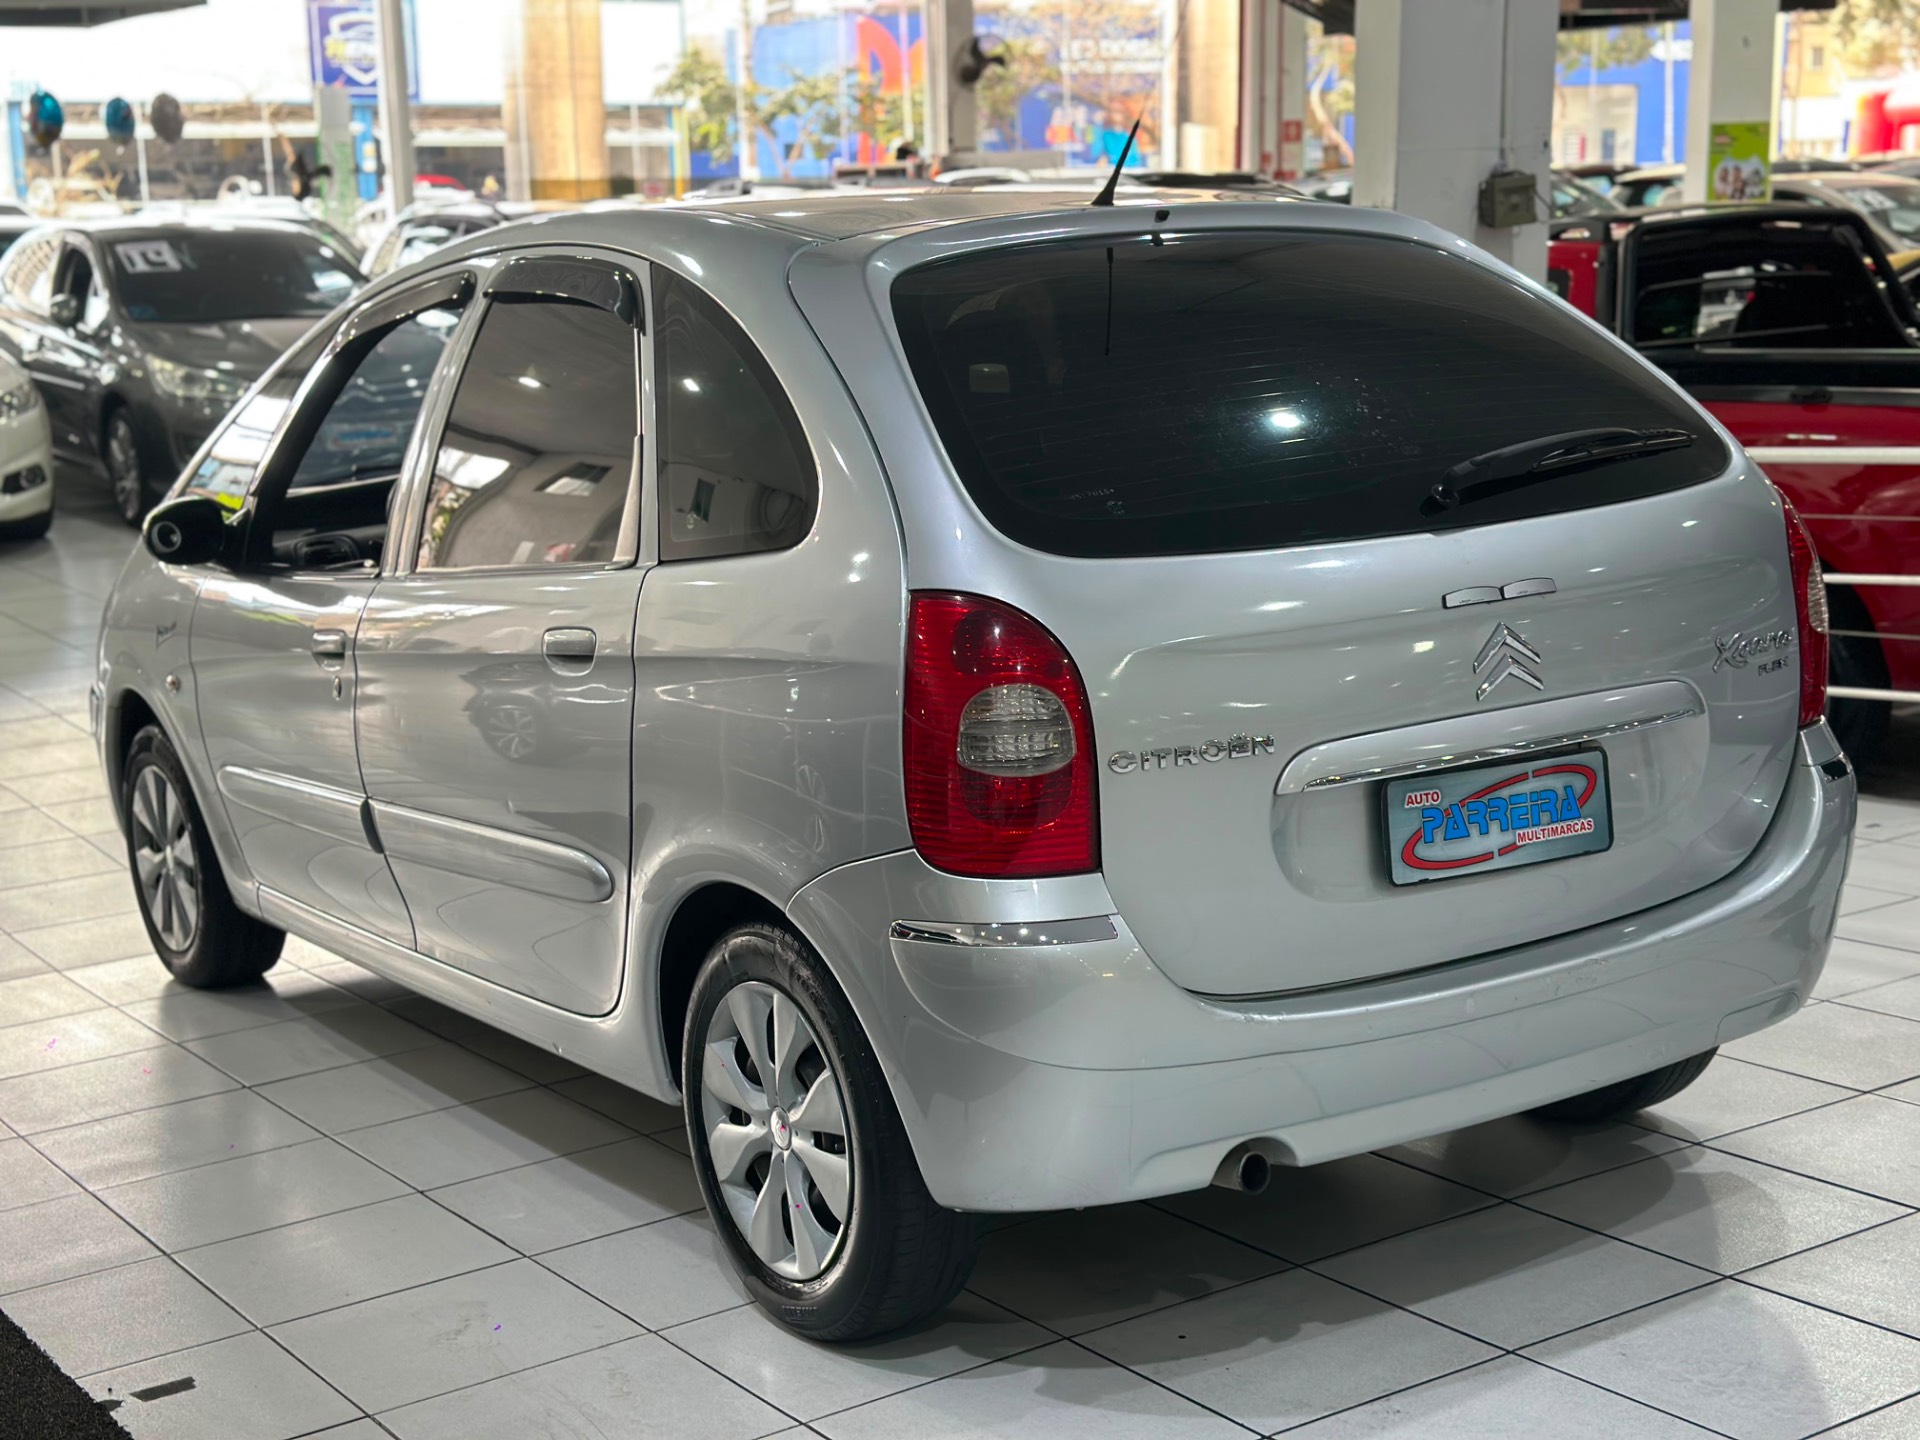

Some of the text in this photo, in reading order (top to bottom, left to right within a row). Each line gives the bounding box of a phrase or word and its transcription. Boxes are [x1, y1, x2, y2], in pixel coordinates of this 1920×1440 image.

[1108, 732, 1275, 774] CITROËN
[1406, 790, 1440, 807] AUTO
[1421, 785, 1582, 844] PARREIRA
[1516, 820, 1594, 844] MULTIMARCAS
